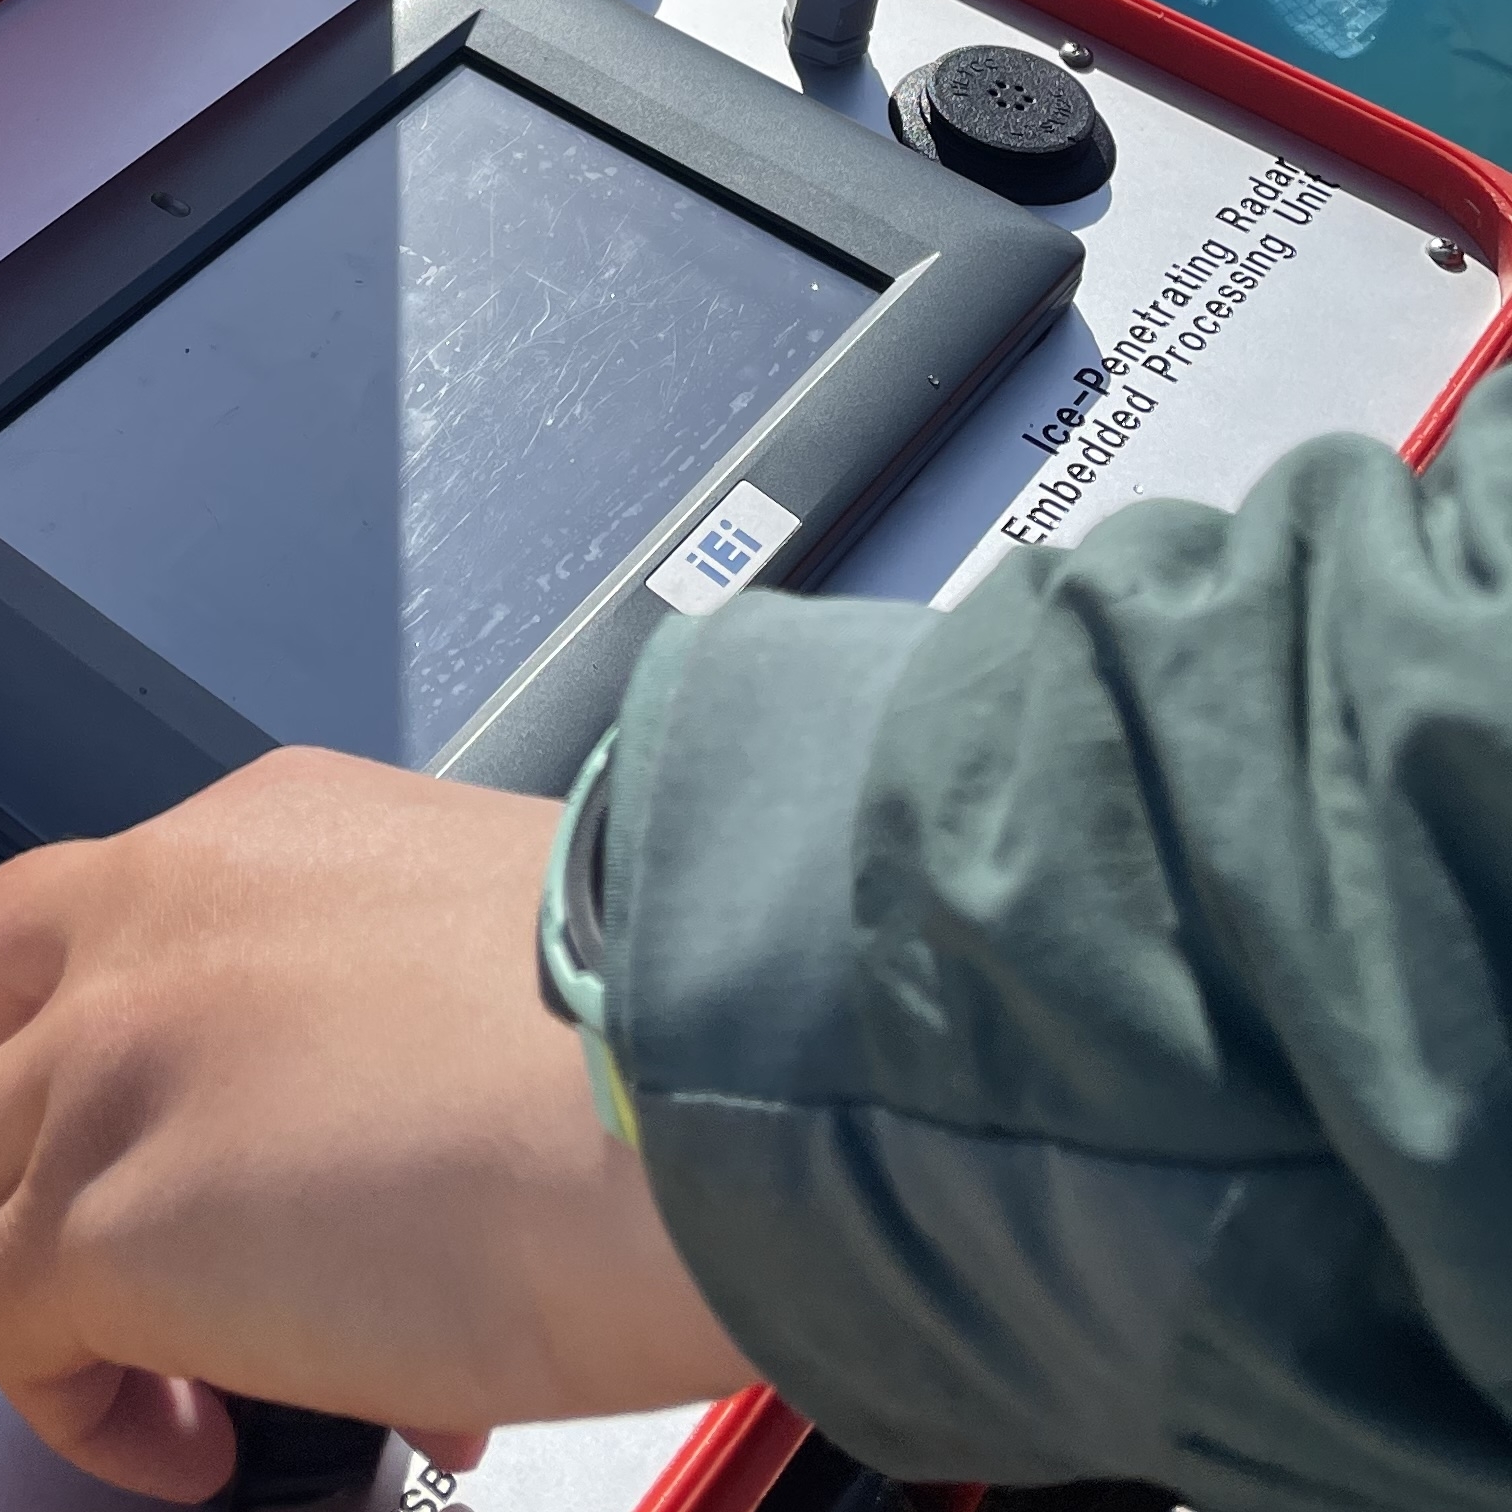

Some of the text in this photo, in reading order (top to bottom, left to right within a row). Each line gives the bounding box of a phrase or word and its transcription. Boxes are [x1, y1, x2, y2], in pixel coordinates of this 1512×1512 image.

[1001, 167, 1341, 544] Embedded Processing Unit
[1022, 156, 1300, 457] Ice-Penetrating Radar
